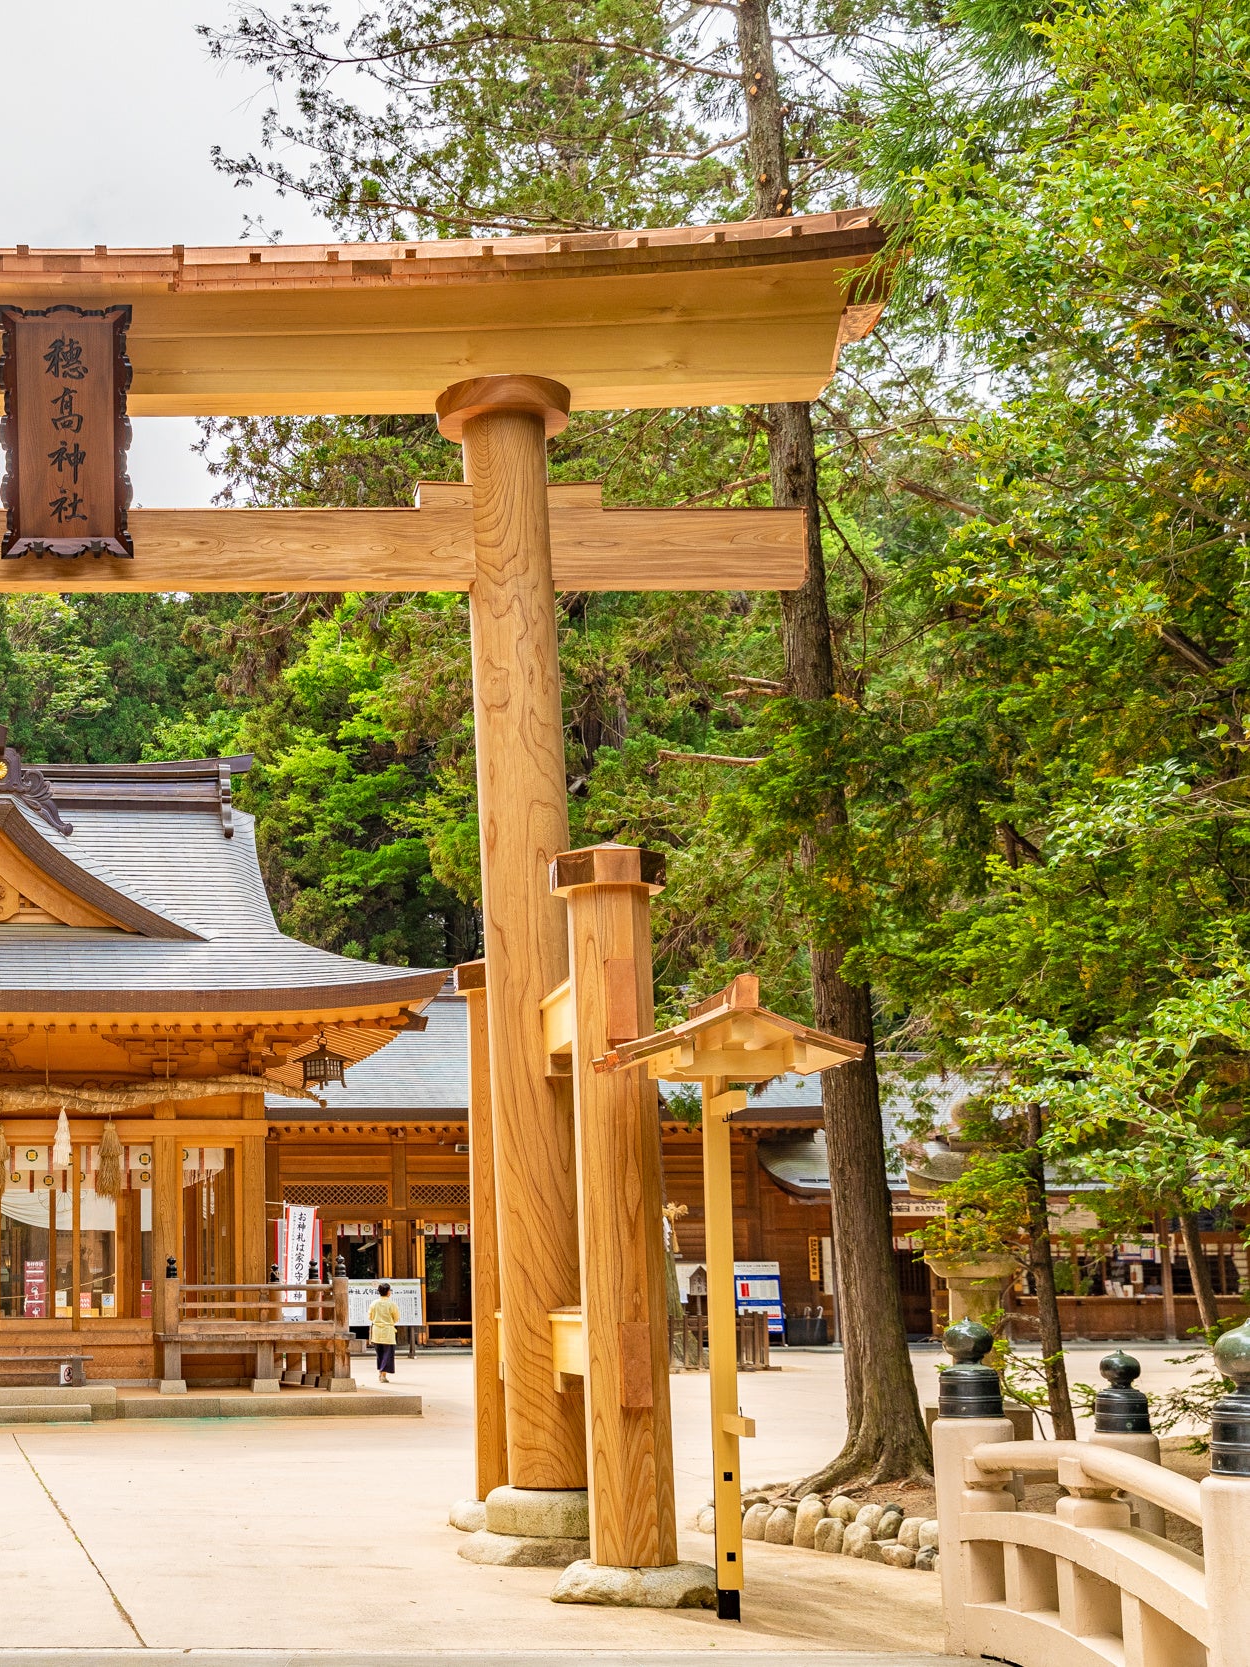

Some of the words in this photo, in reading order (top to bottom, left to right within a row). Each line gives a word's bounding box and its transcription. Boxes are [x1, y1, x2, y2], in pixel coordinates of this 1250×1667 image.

[294, 1212, 307, 1300] お神札は家の守神
